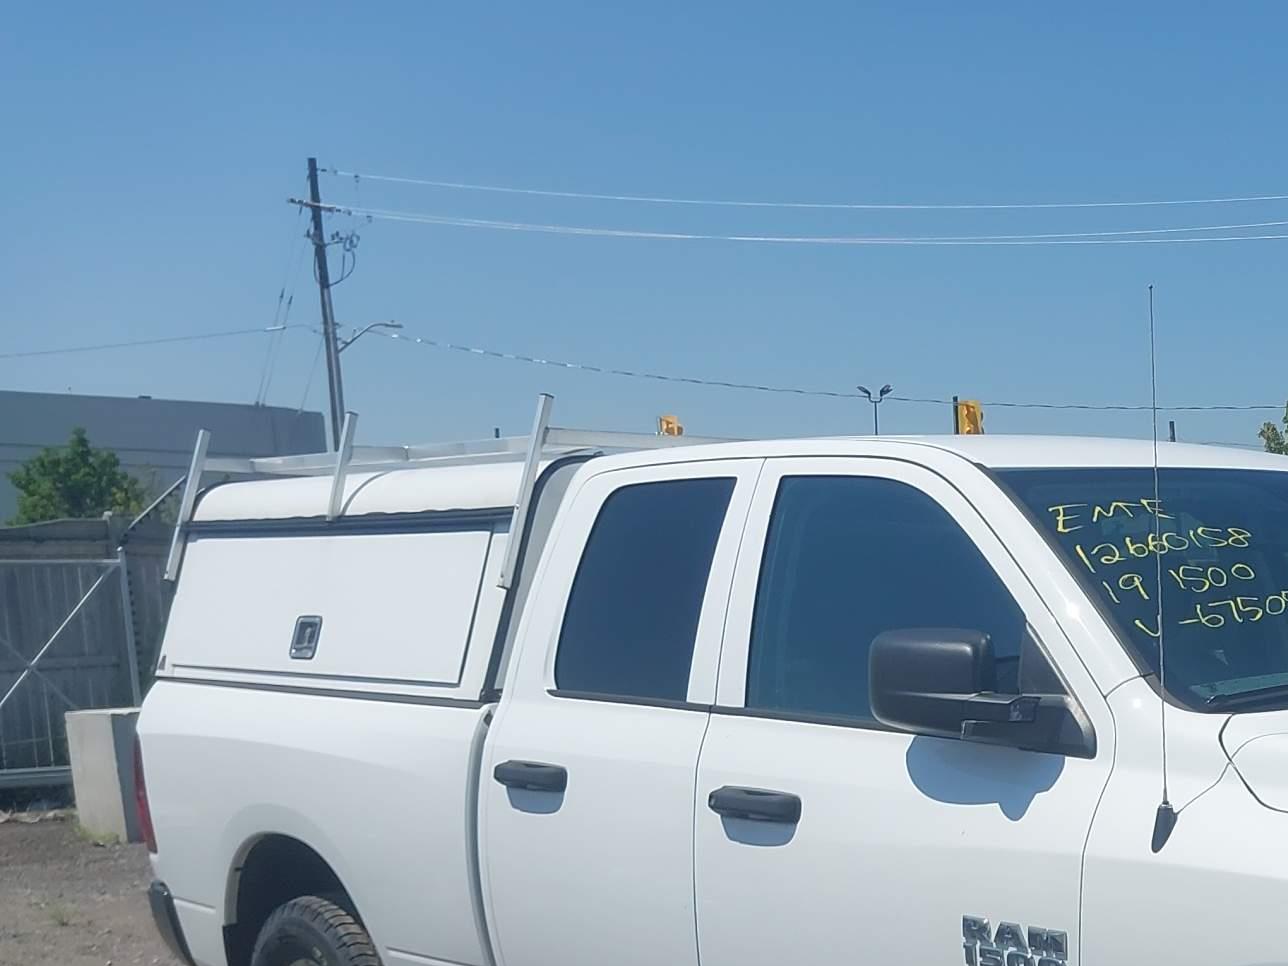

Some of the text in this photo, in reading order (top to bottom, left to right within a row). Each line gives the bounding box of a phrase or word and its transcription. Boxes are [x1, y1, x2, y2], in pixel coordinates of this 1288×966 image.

[1076, 526, 1252, 573] 12660158
[1103, 563, 1256, 604] 19 1500
[962, 914, 1068, 961] RAM
